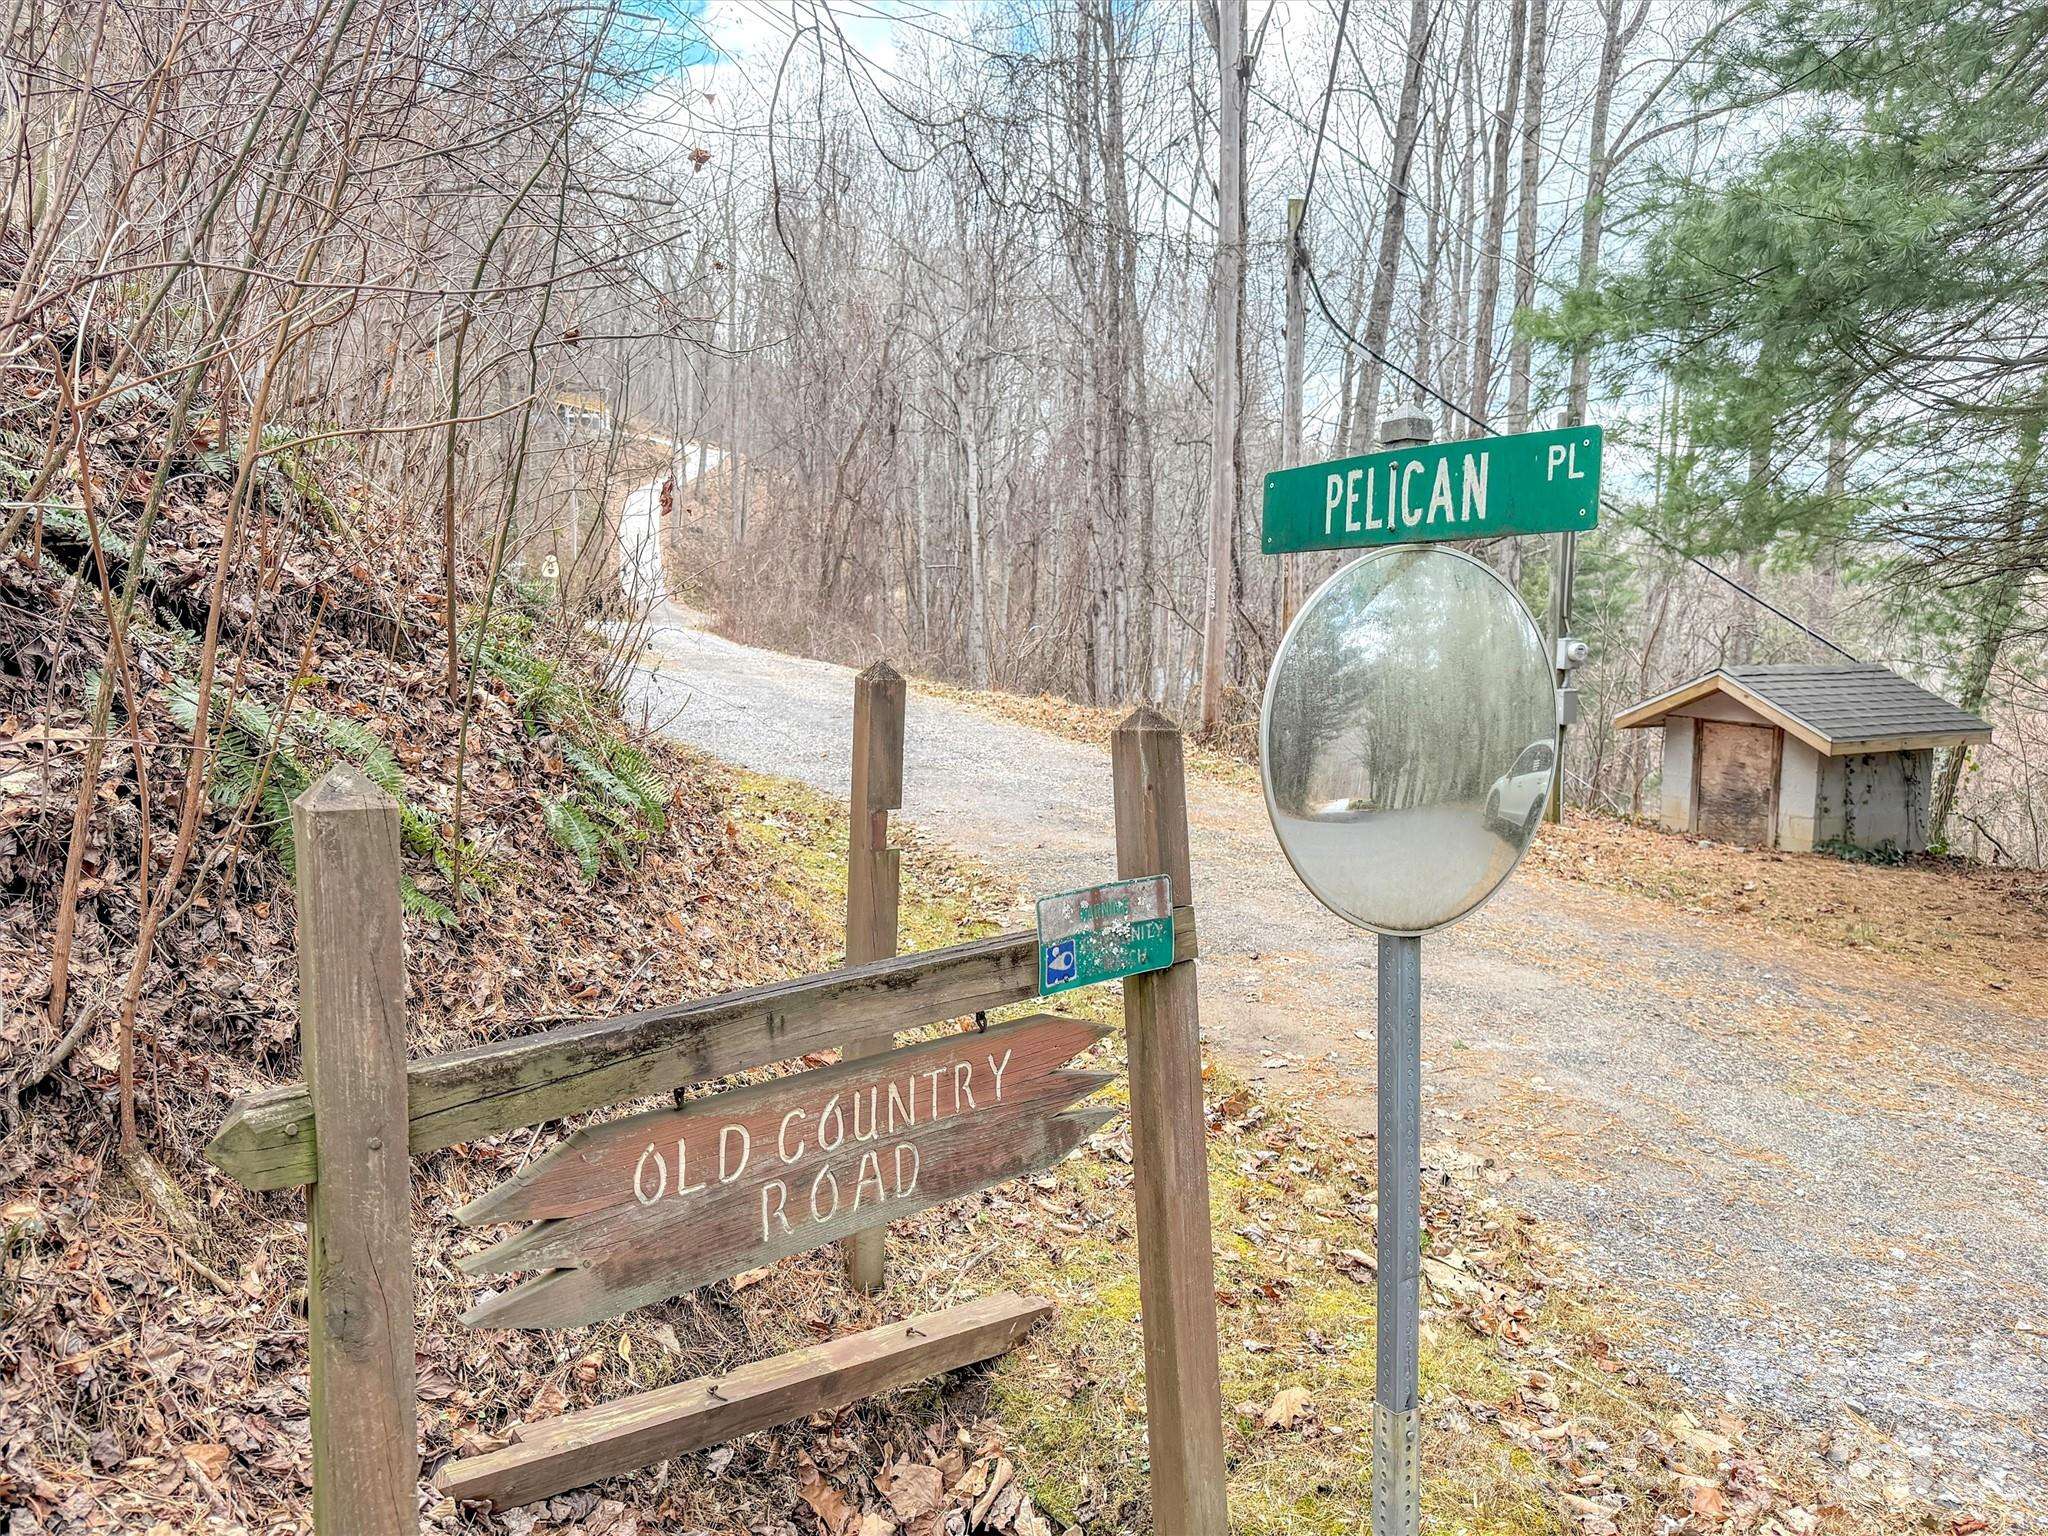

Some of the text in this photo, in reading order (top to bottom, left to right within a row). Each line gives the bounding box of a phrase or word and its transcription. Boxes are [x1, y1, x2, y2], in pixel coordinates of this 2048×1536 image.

[1325, 443, 1585, 534] PELICAN PL
[633, 1048, 1012, 1204] OLD COUNTRY
[761, 1141, 921, 1242] ROAD
